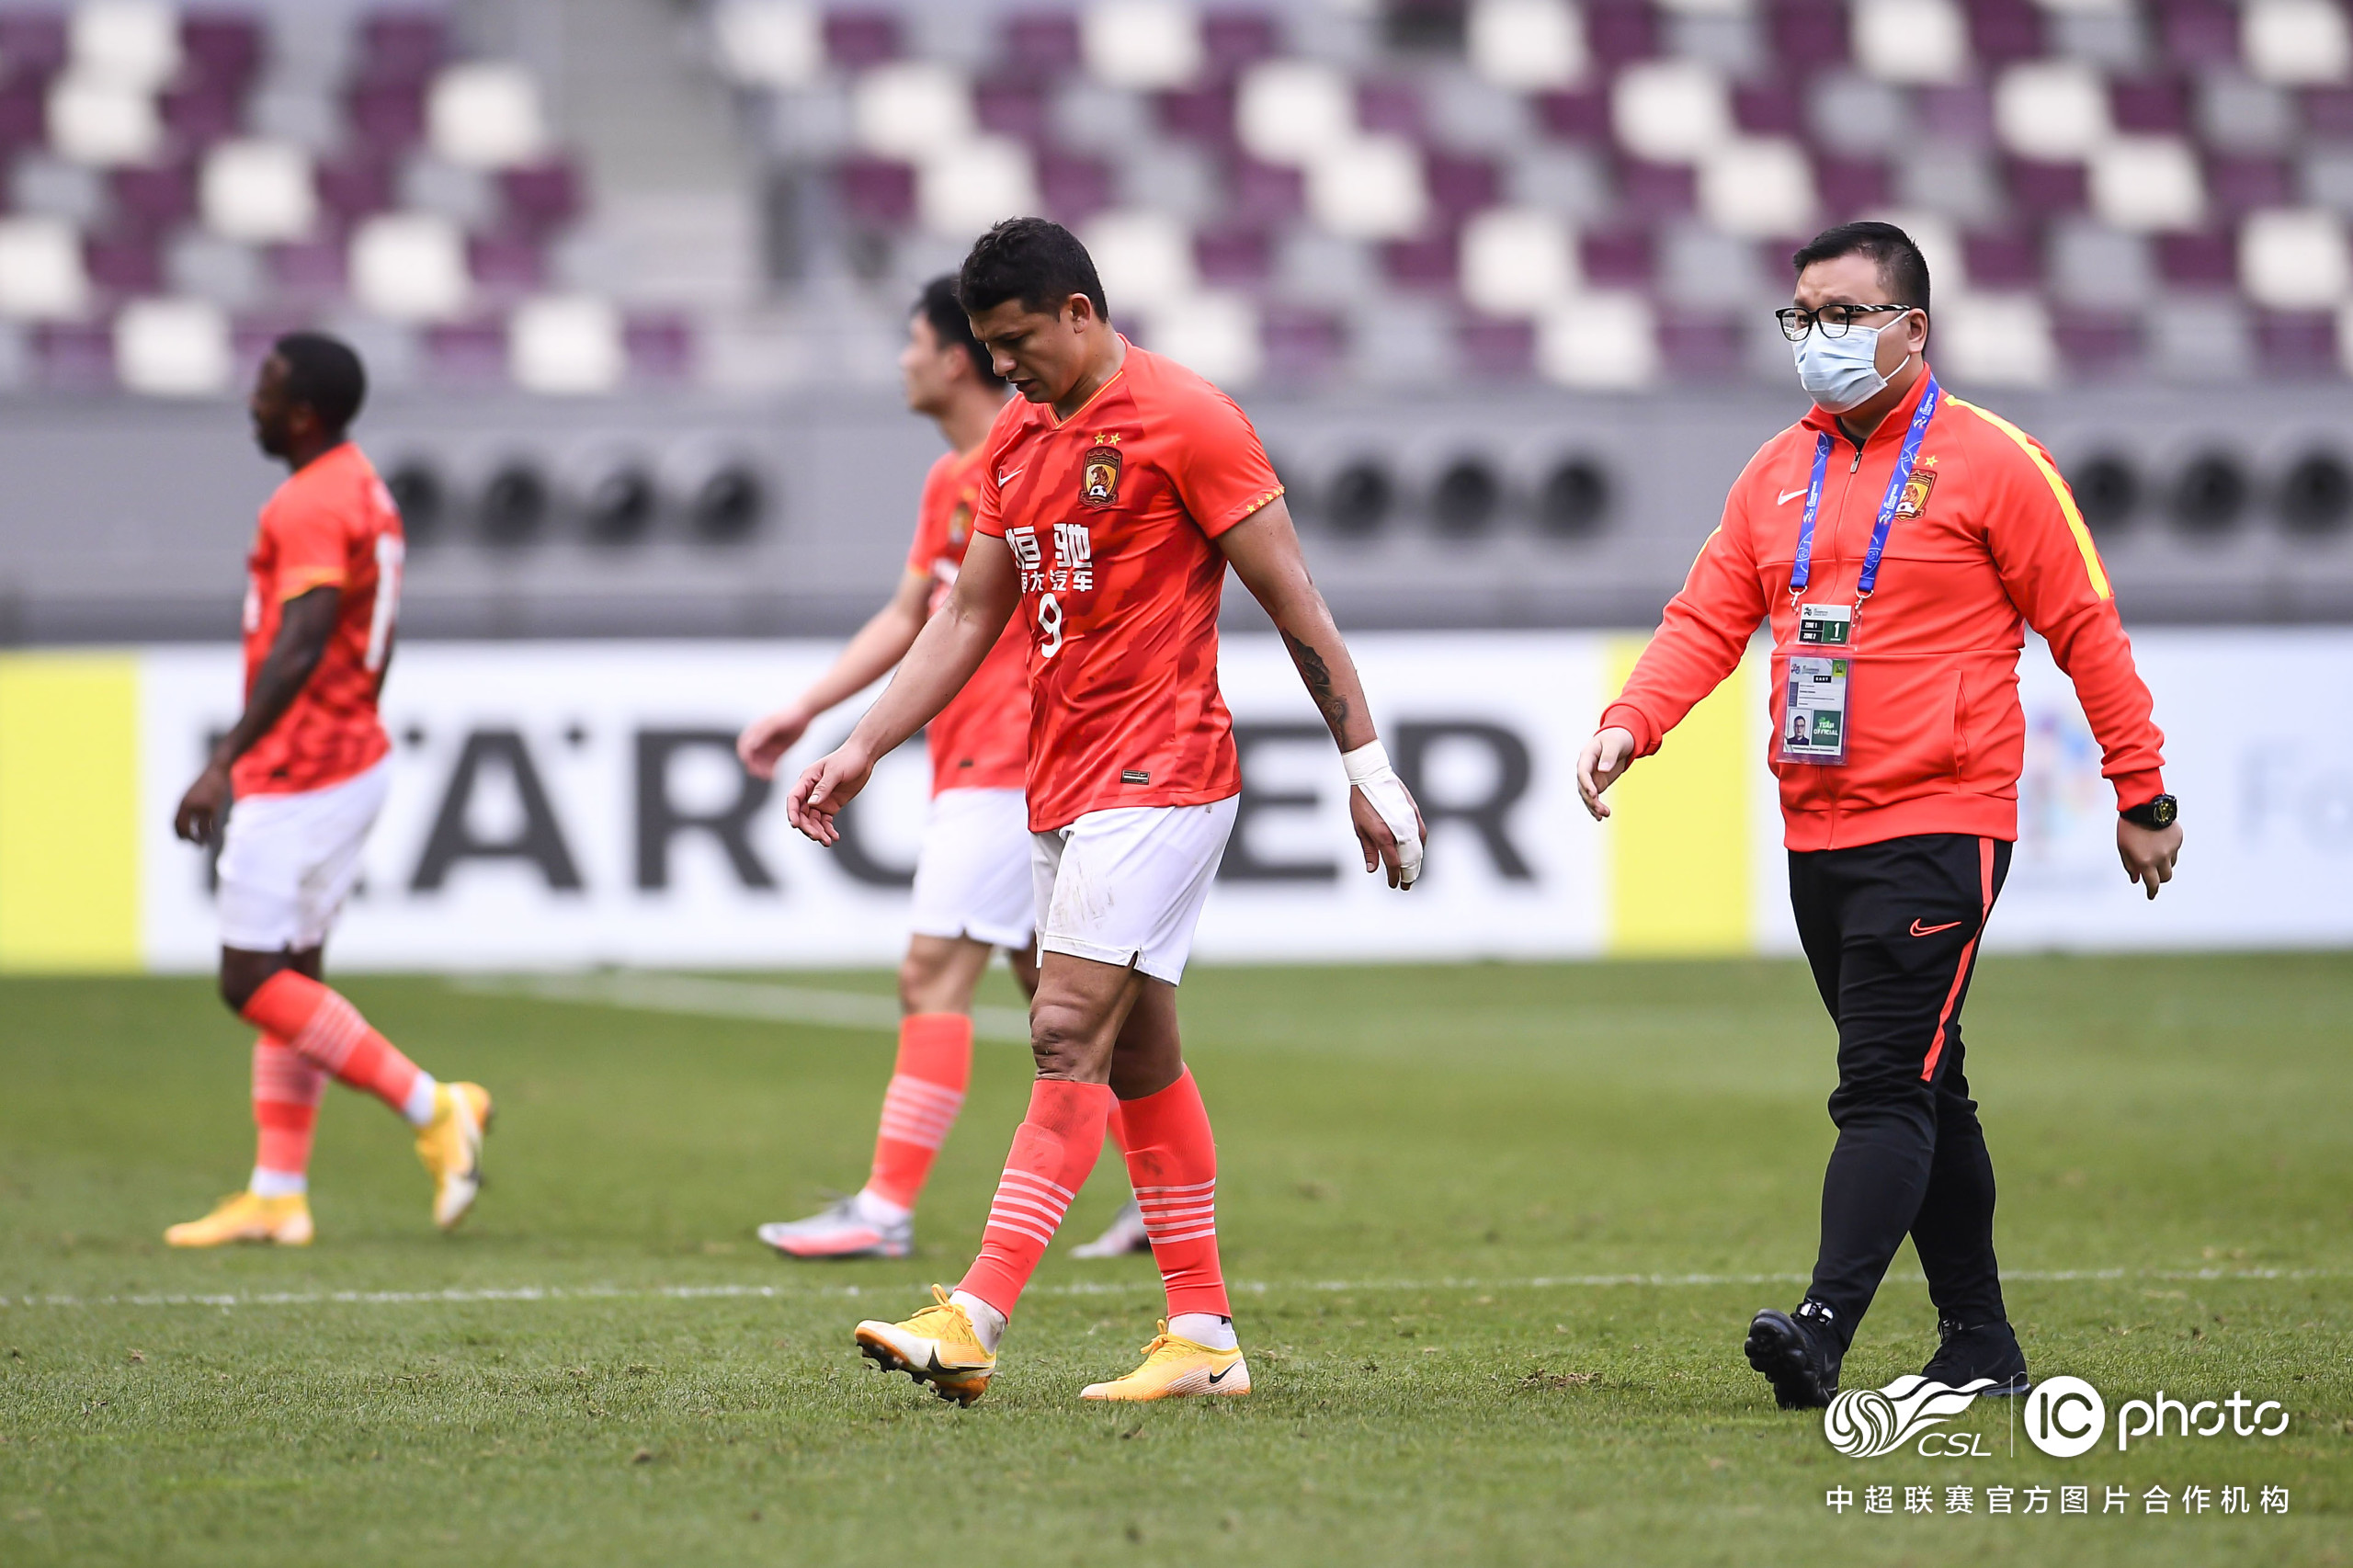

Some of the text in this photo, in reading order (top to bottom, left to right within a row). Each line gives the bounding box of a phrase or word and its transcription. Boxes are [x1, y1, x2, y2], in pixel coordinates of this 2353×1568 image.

[1005, 523, 1093, 570] 恒驰
[1039, 593, 1063, 658] 9
[1834, 622, 1840, 638] 1
[204, 722, 1533, 891] ÄRCER
